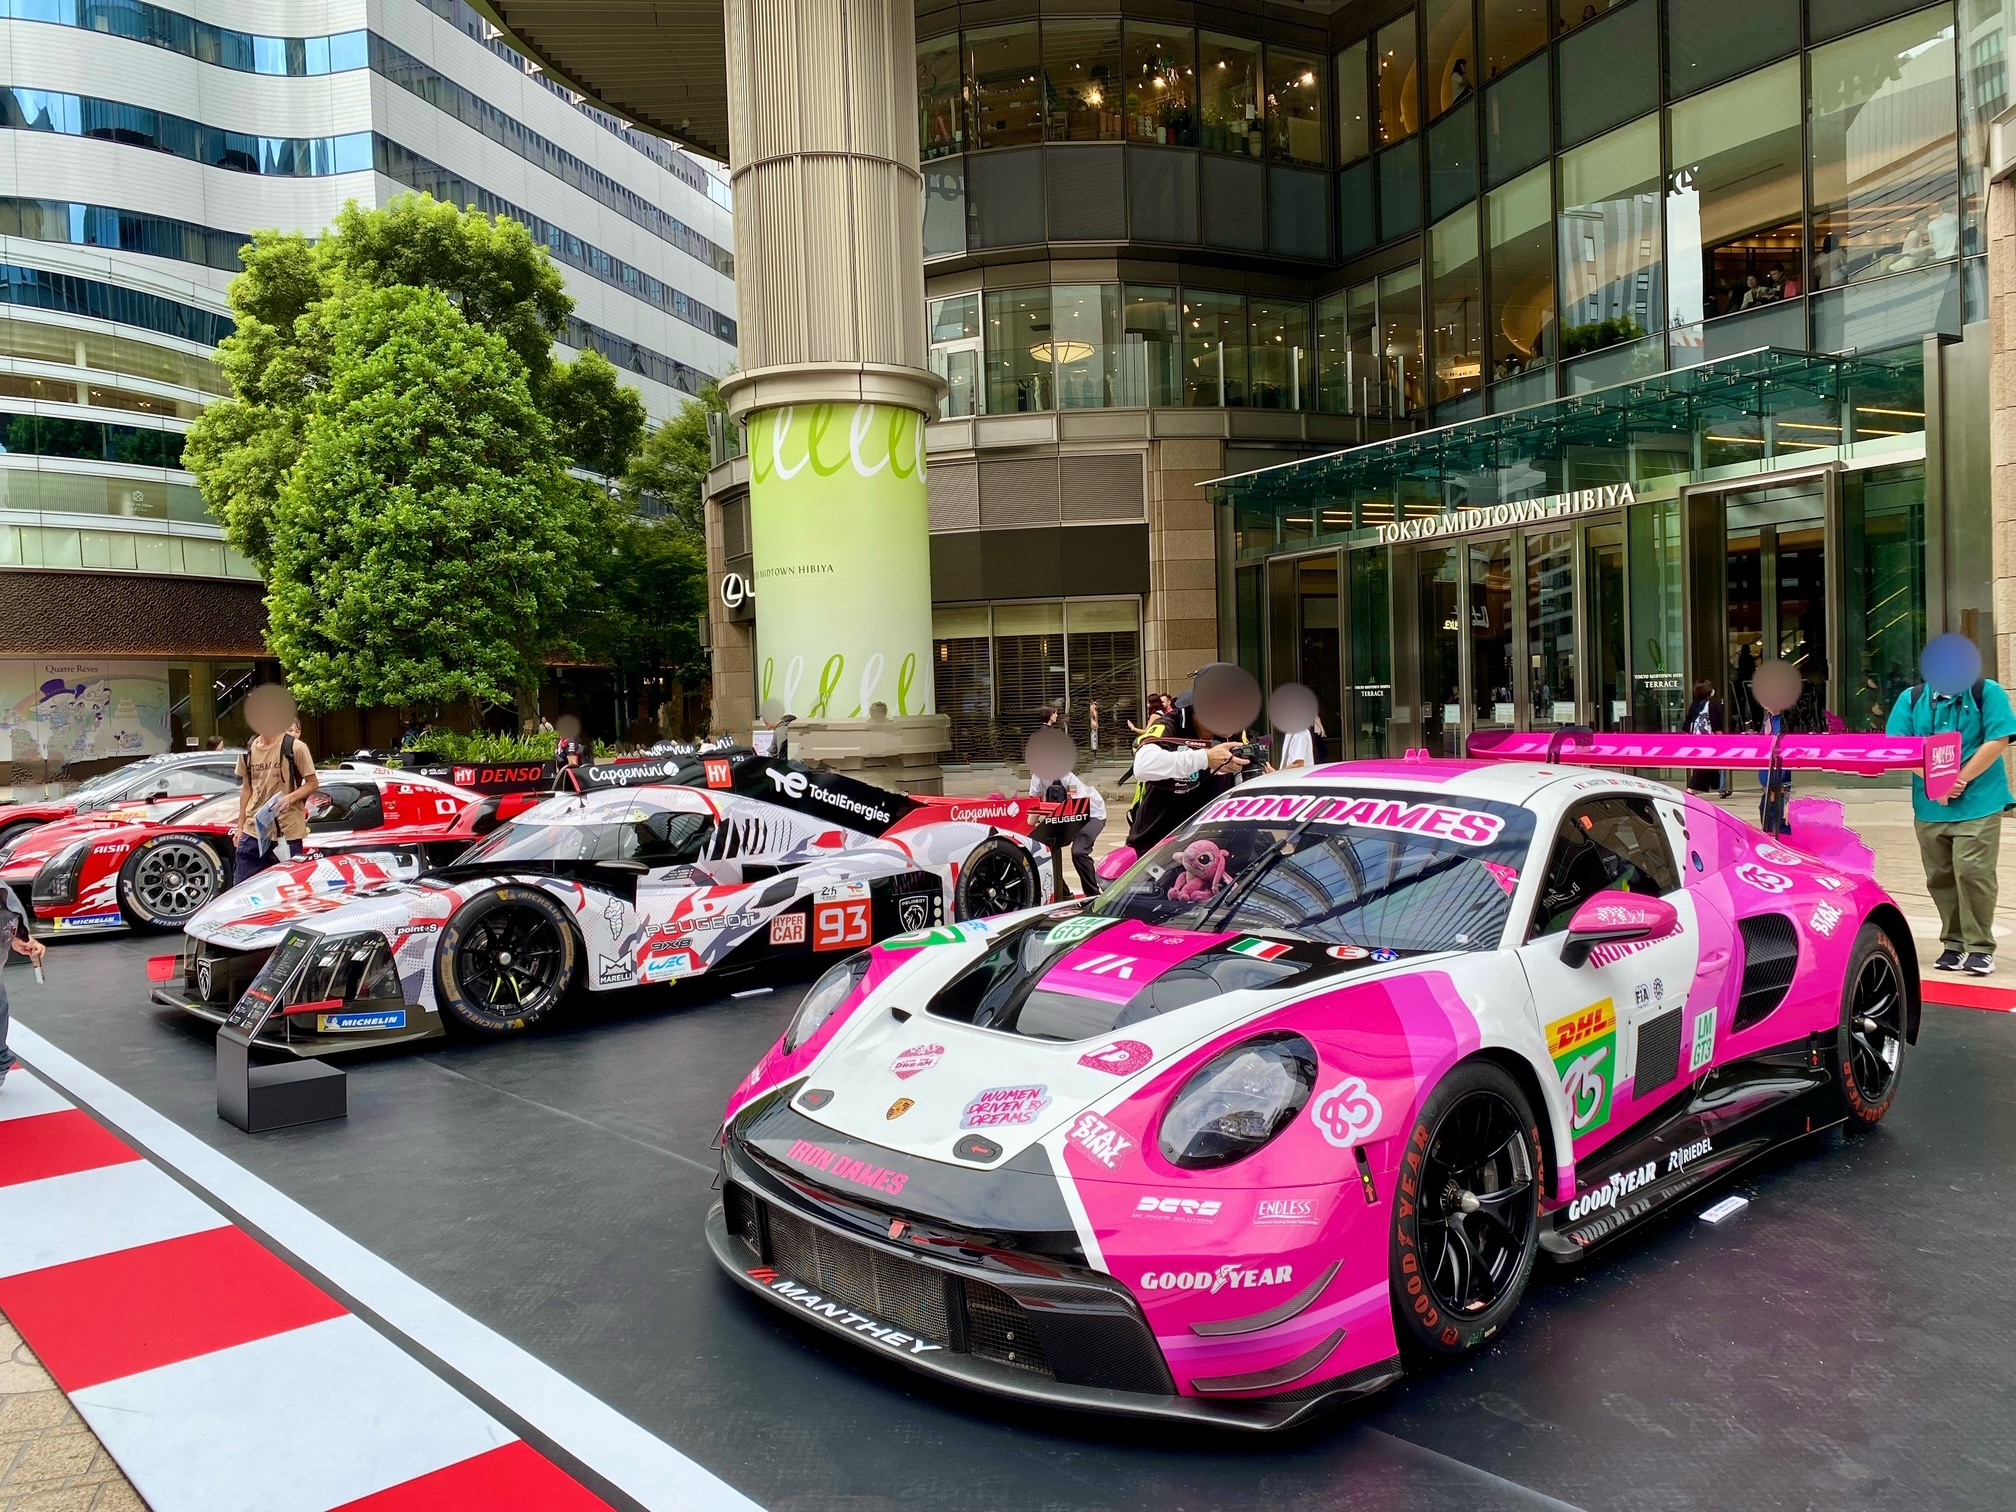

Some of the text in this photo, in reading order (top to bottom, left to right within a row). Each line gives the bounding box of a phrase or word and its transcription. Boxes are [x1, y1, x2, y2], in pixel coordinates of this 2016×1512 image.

[1376, 482, 1635, 543] TOKYO MIDTOWN HIBIYA
[760, 566, 795, 578] MIDTOWN
[798, 564, 834, 574] HIBIYA
[45, 664, 99, 674] Quatre Rêves
[1644, 680, 1679, 688] TERRACE
[456, 769, 473, 782] HY
[481, 767, 541, 783] DENSO
[589, 763, 663, 786] Capgemini
[707, 765, 727, 782] HY
[809, 783, 891, 823] TotalEnergies
[951, 803, 1007, 823] Capgemini
[1045, 813, 1088, 825] PEUGEOT
[1204, 797, 1498, 842] IRON DAMES
[159, 834, 198, 844] MICHELIN
[94, 844, 130, 855] AISIN
[308, 852, 324, 861] #94
[338, 855, 403, 867] PEUGEOT
[518, 892, 562, 920] MICHELIN
[72, 916, 115, 926] MICHELIN
[645, 912, 755, 937] PEUGEOT
[773, 916, 803, 927] HYPER
[819, 905, 867, 944] 93
[1607, 909, 1645, 925] KW
[773, 925, 803, 941] CAR
[1051, 924, 1089, 941] GT3
[651, 937, 693, 951] 9X8
[648, 955, 687, 971] WEC
[600, 973, 632, 984] MARELLI
[1636, 987, 1650, 1005] FIA
[341, 1016, 397, 1027] MICHELIN
[456, 1003, 504, 1030] MICHELIN
[1557, 1008, 1607, 1050] DHL
[1697, 1012, 1713, 1040] LM
[1693, 1038, 1712, 1066] GT3
[894, 1060, 933, 1069] DREAM
[981, 1088, 1042, 1102] WOMEN
[966, 1099, 1048, 1115] DRIVEN BY
[967, 1111, 1033, 1126] DREAMS
[1079, 1114, 1134, 1151] STAY
[1684, 1137, 1713, 1164] RIEDEL
[785, 1139, 909, 1196] IRON DAMES
[1258, 1200, 1312, 1216] ENDLESS
[771, 1281, 942, 1354] MANTHEY
